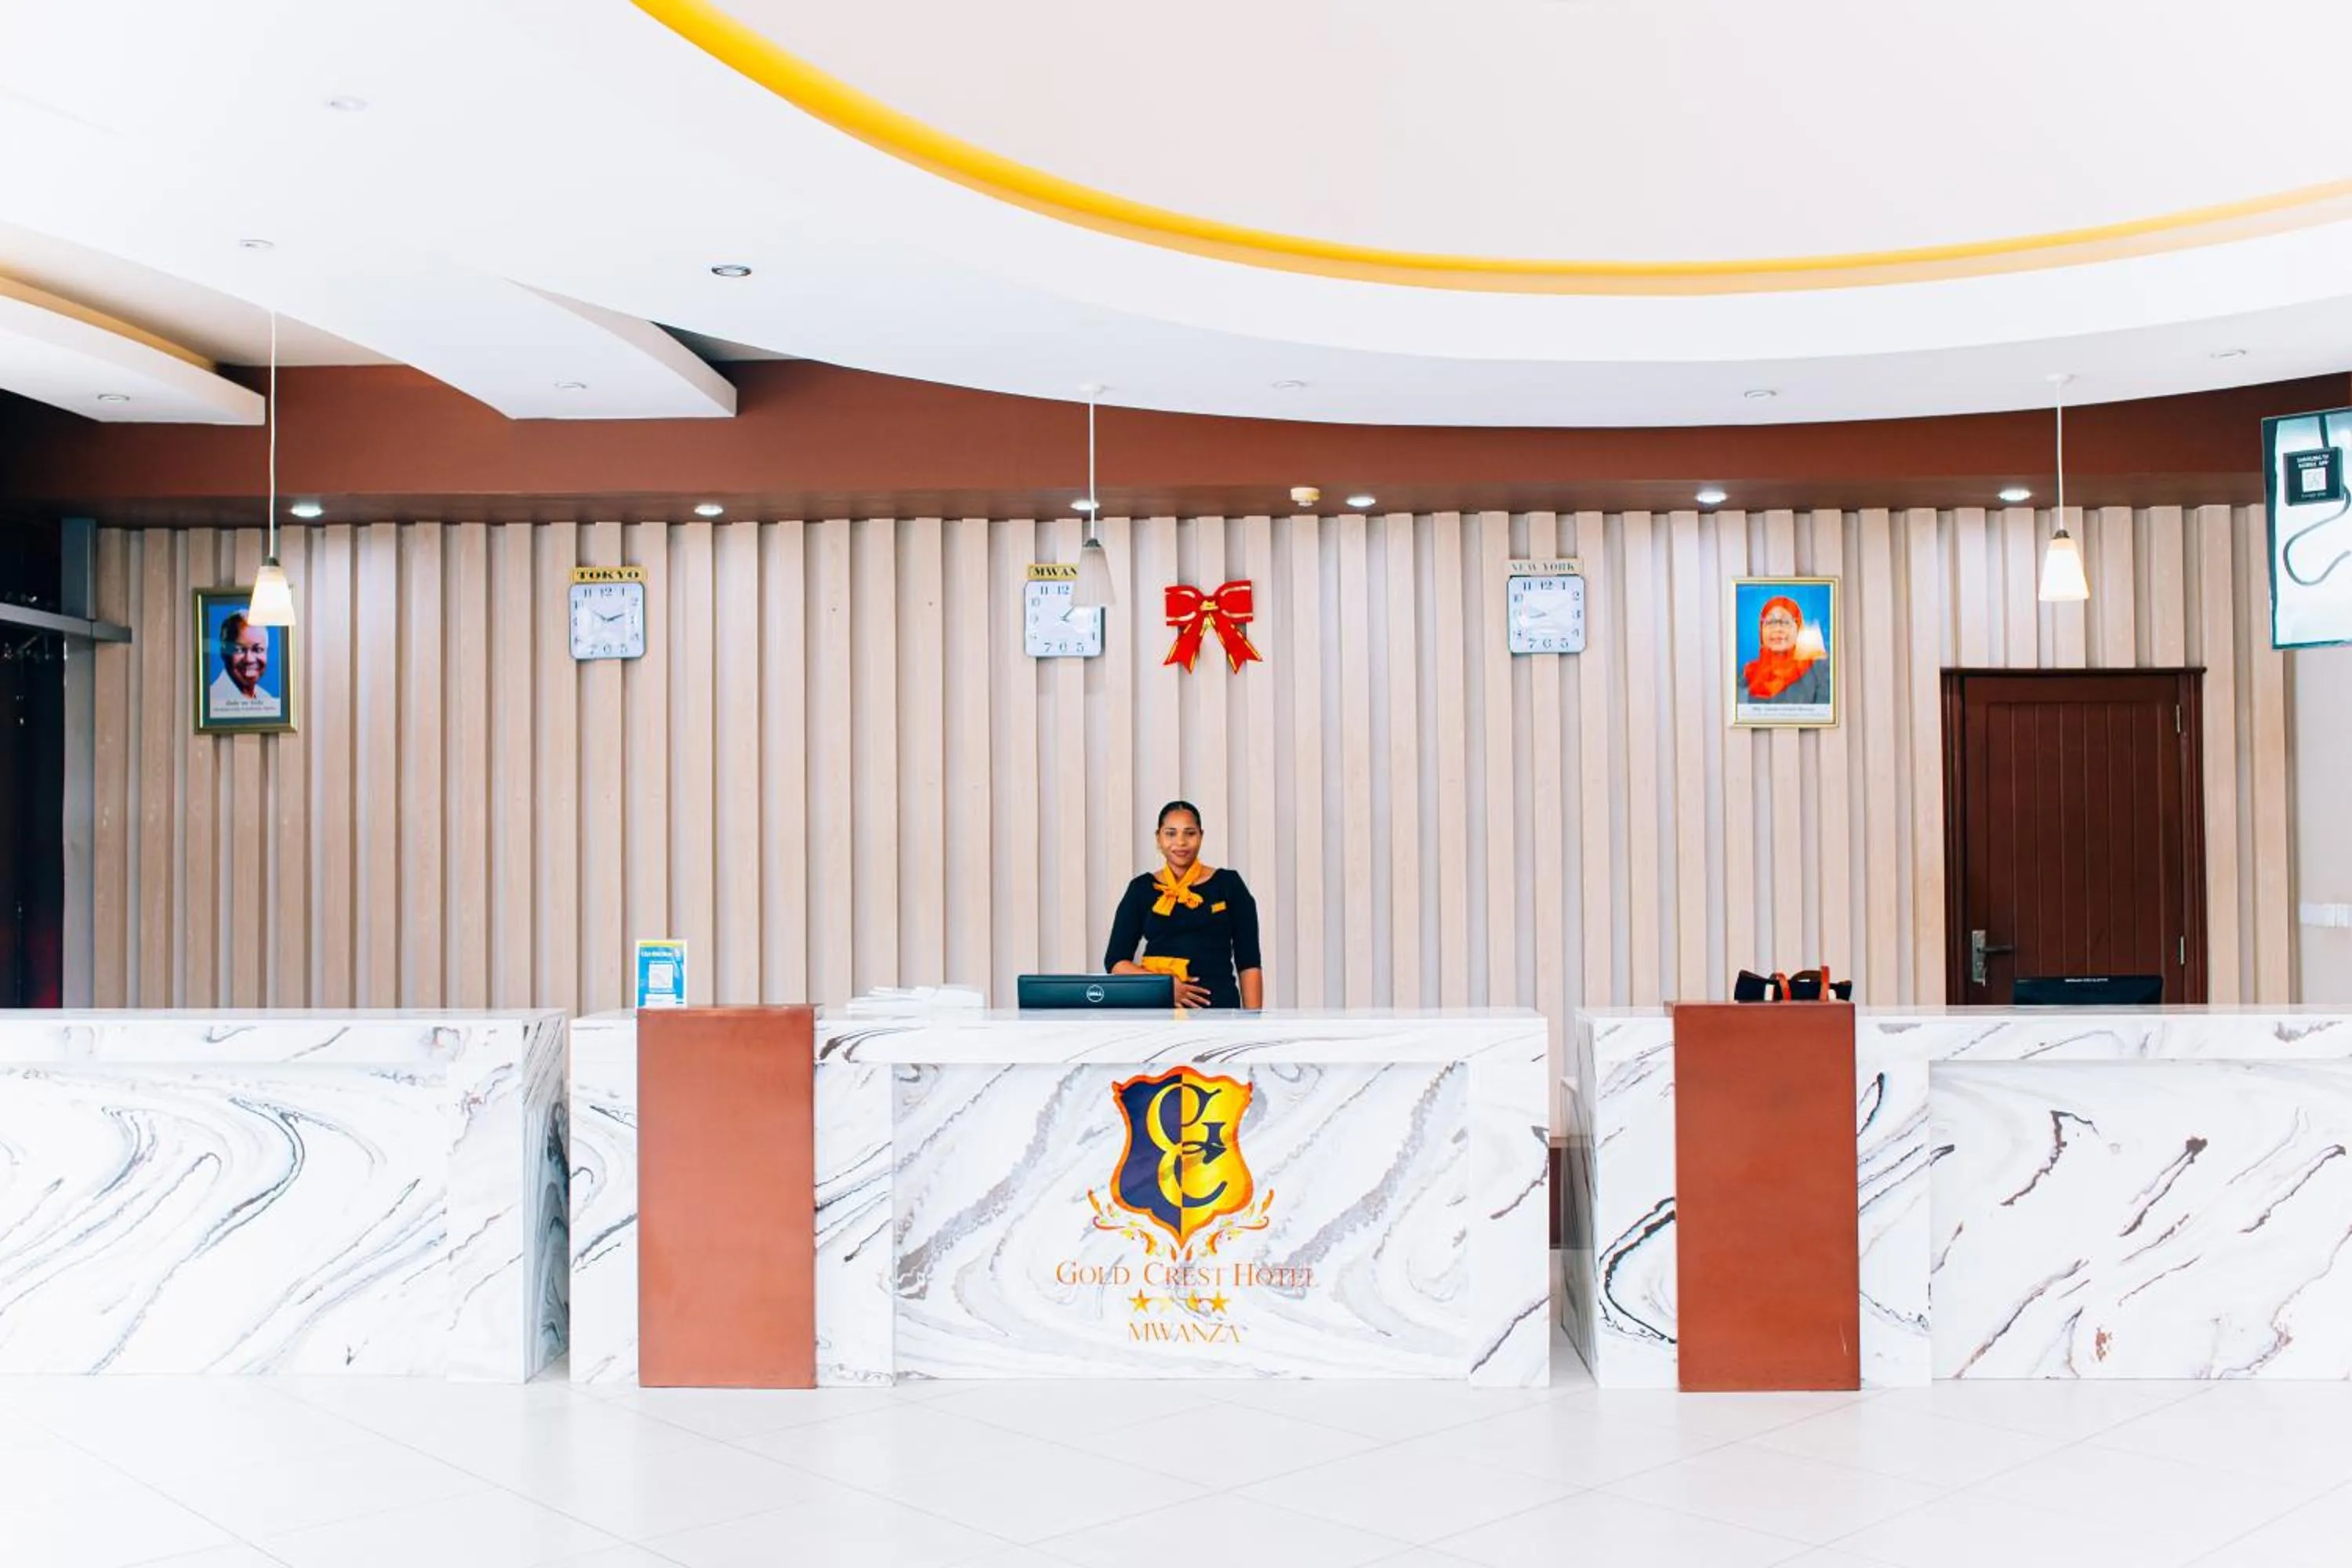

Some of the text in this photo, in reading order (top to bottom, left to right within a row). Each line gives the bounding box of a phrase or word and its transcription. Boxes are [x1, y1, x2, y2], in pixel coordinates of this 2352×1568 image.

[1034, 567, 1078, 577] MWAN
[1511, 562, 1576, 572] NEW YORK
[577, 570, 640, 580] TOKYO
[1058, 585, 1070, 595] 12
[1541, 580, 1553, 590] 12
[1056, 1259, 1316, 1288] GOLD CREST HOTEL
[1129, 1321, 1240, 1344] MWANZA
